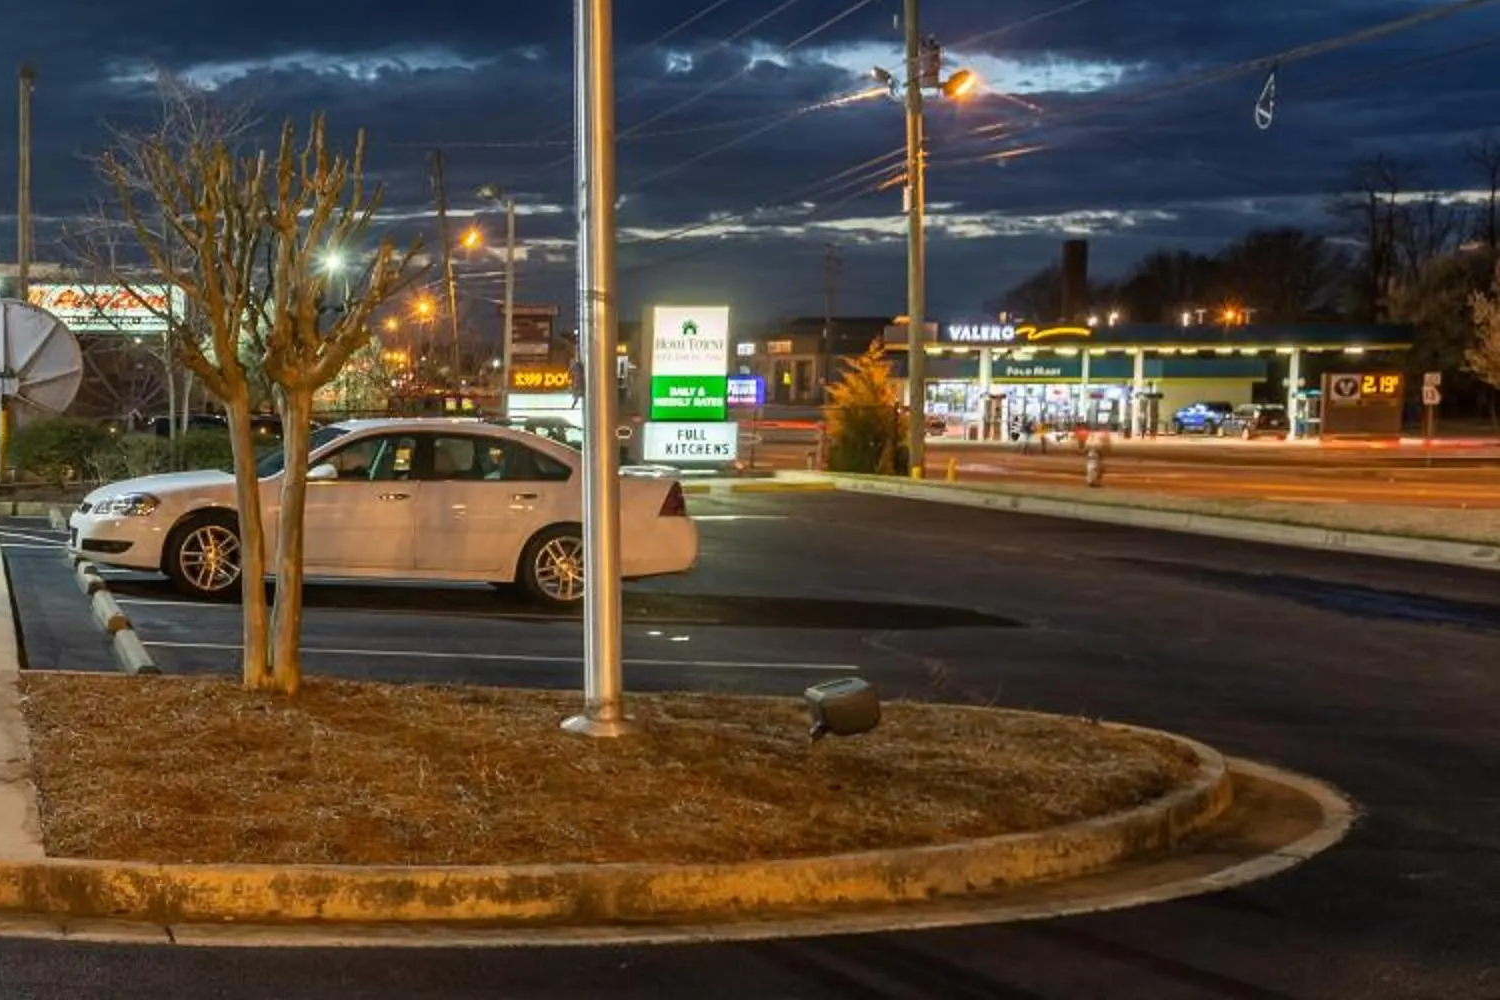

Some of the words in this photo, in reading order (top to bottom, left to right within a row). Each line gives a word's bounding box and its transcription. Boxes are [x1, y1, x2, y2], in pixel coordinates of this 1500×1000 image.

[950, 325, 1014, 340] VALERO
[677, 429, 707, 441] FULL
[665, 443, 730, 456] KITCHENS
